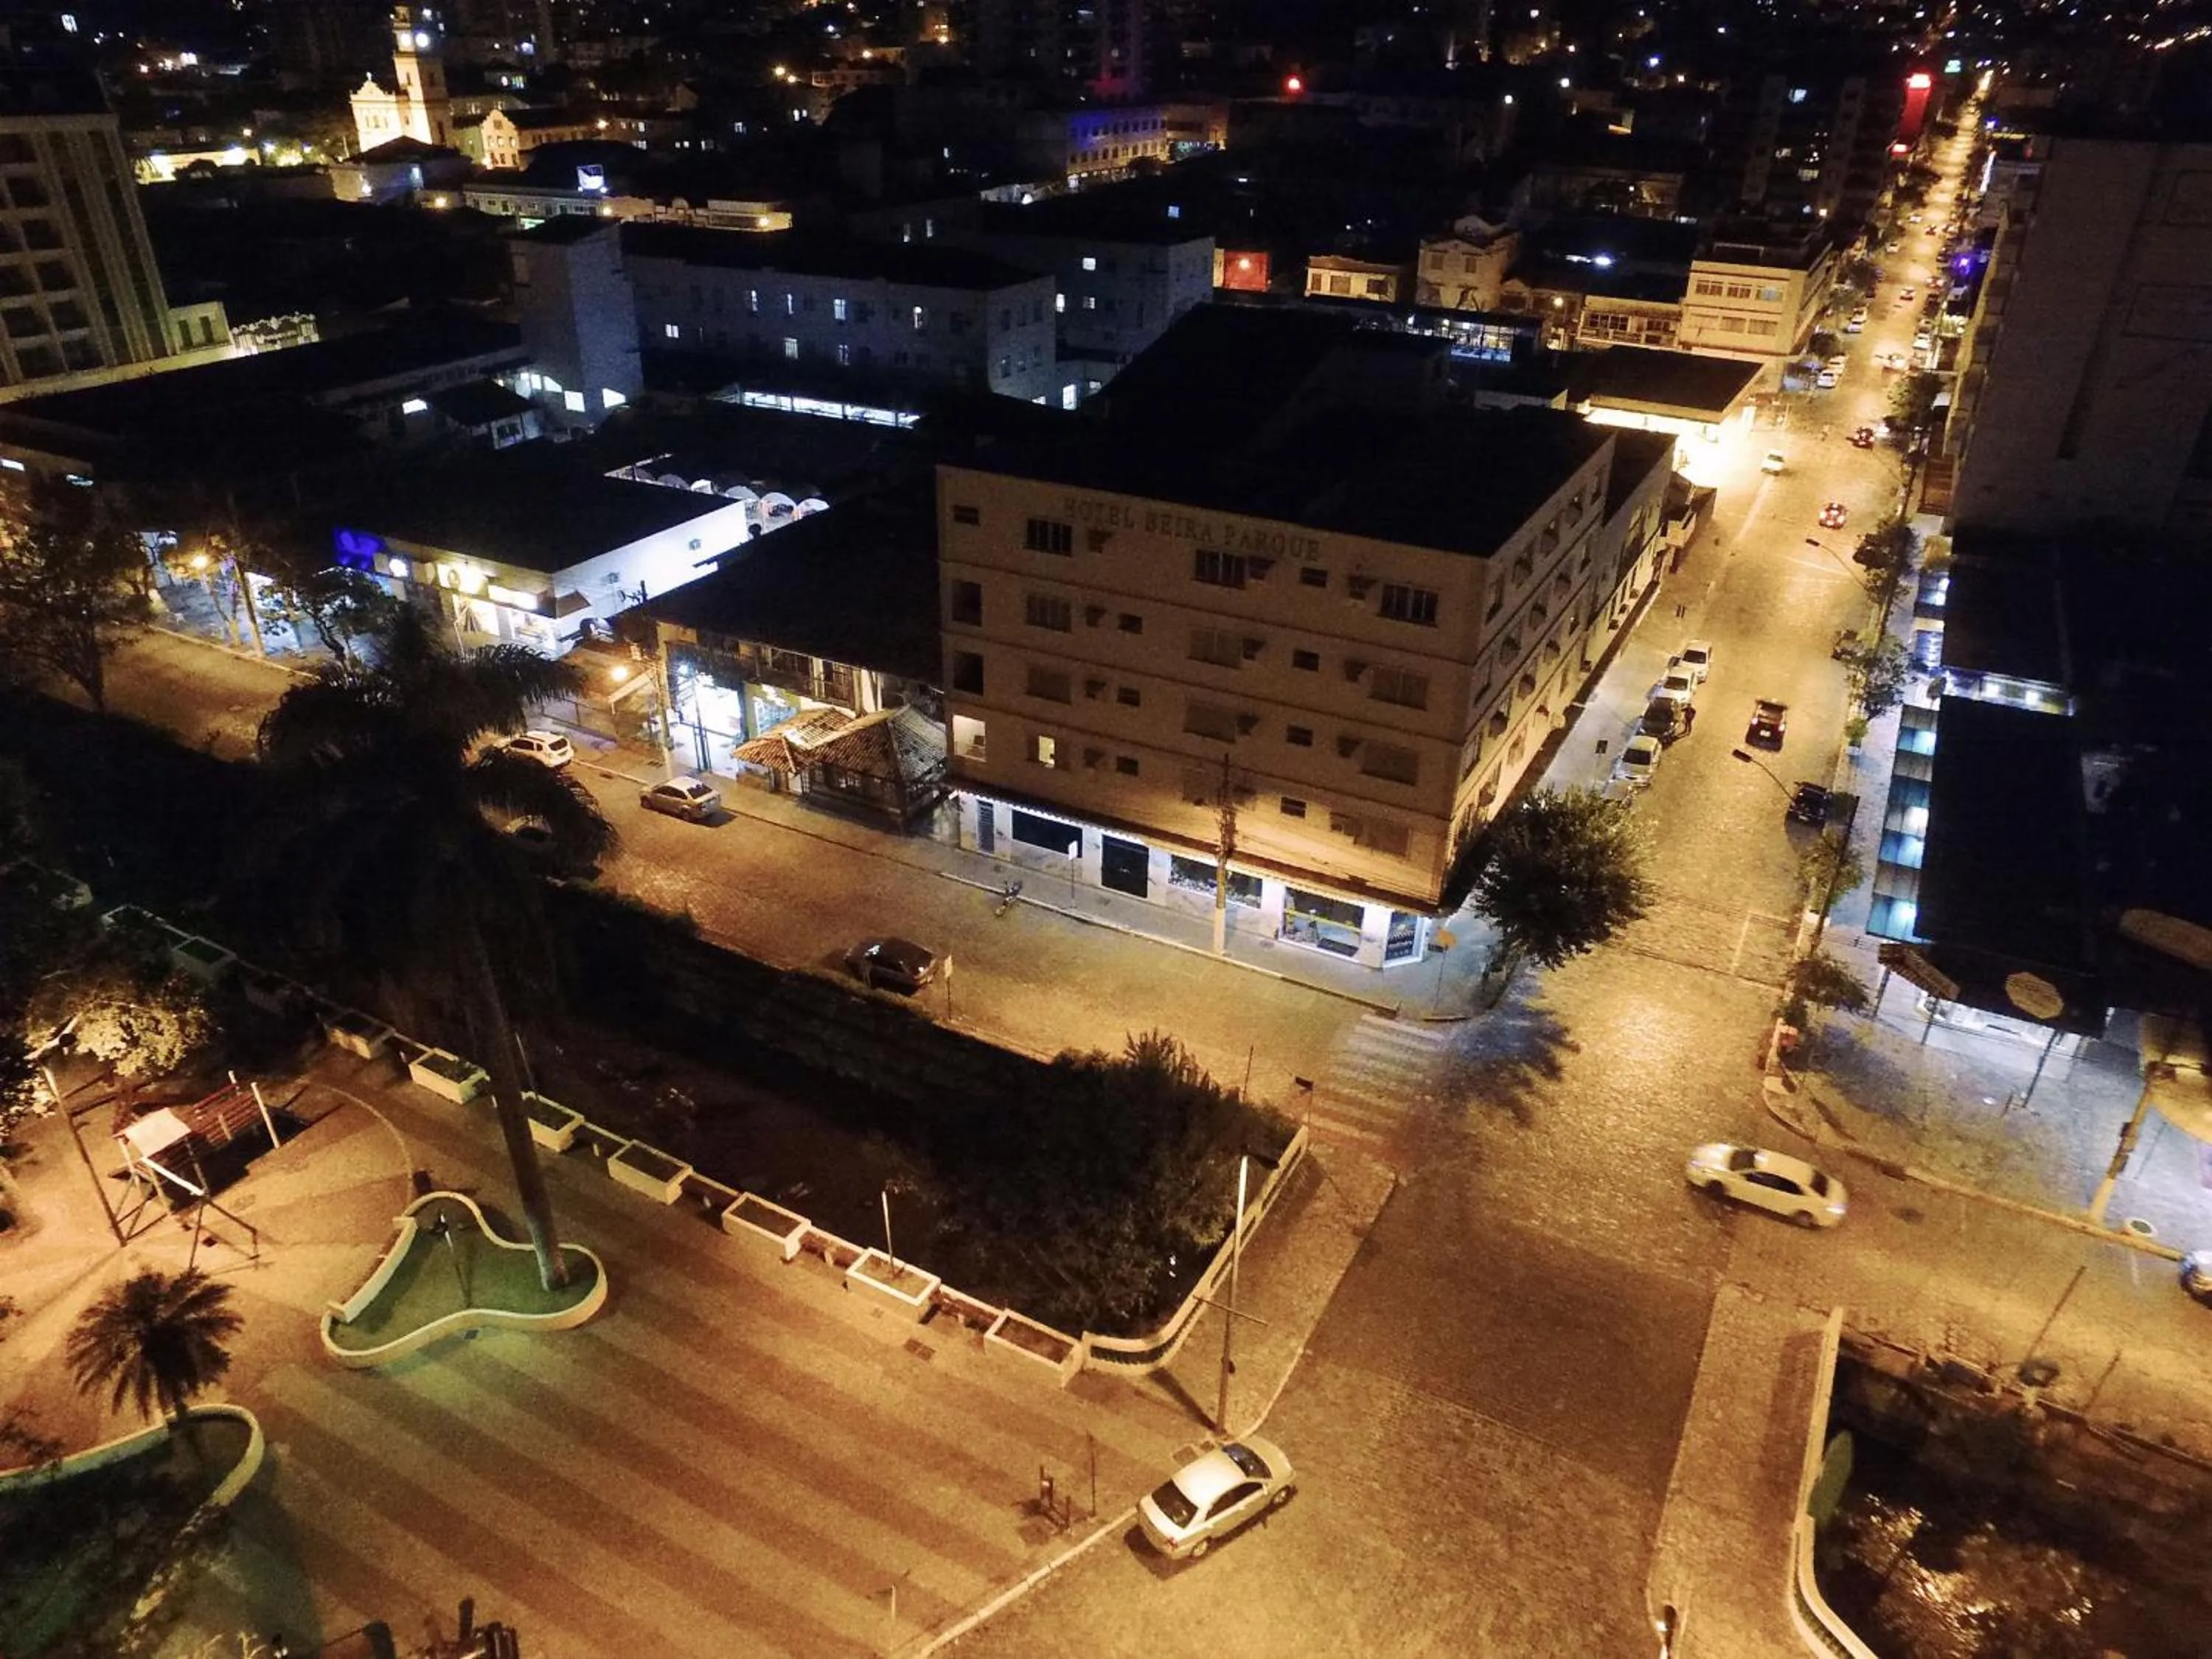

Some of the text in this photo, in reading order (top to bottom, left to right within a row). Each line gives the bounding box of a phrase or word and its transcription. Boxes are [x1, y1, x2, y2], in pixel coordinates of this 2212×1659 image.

[1064, 498, 1321, 561] HOTEL BEIRA PARQUE
